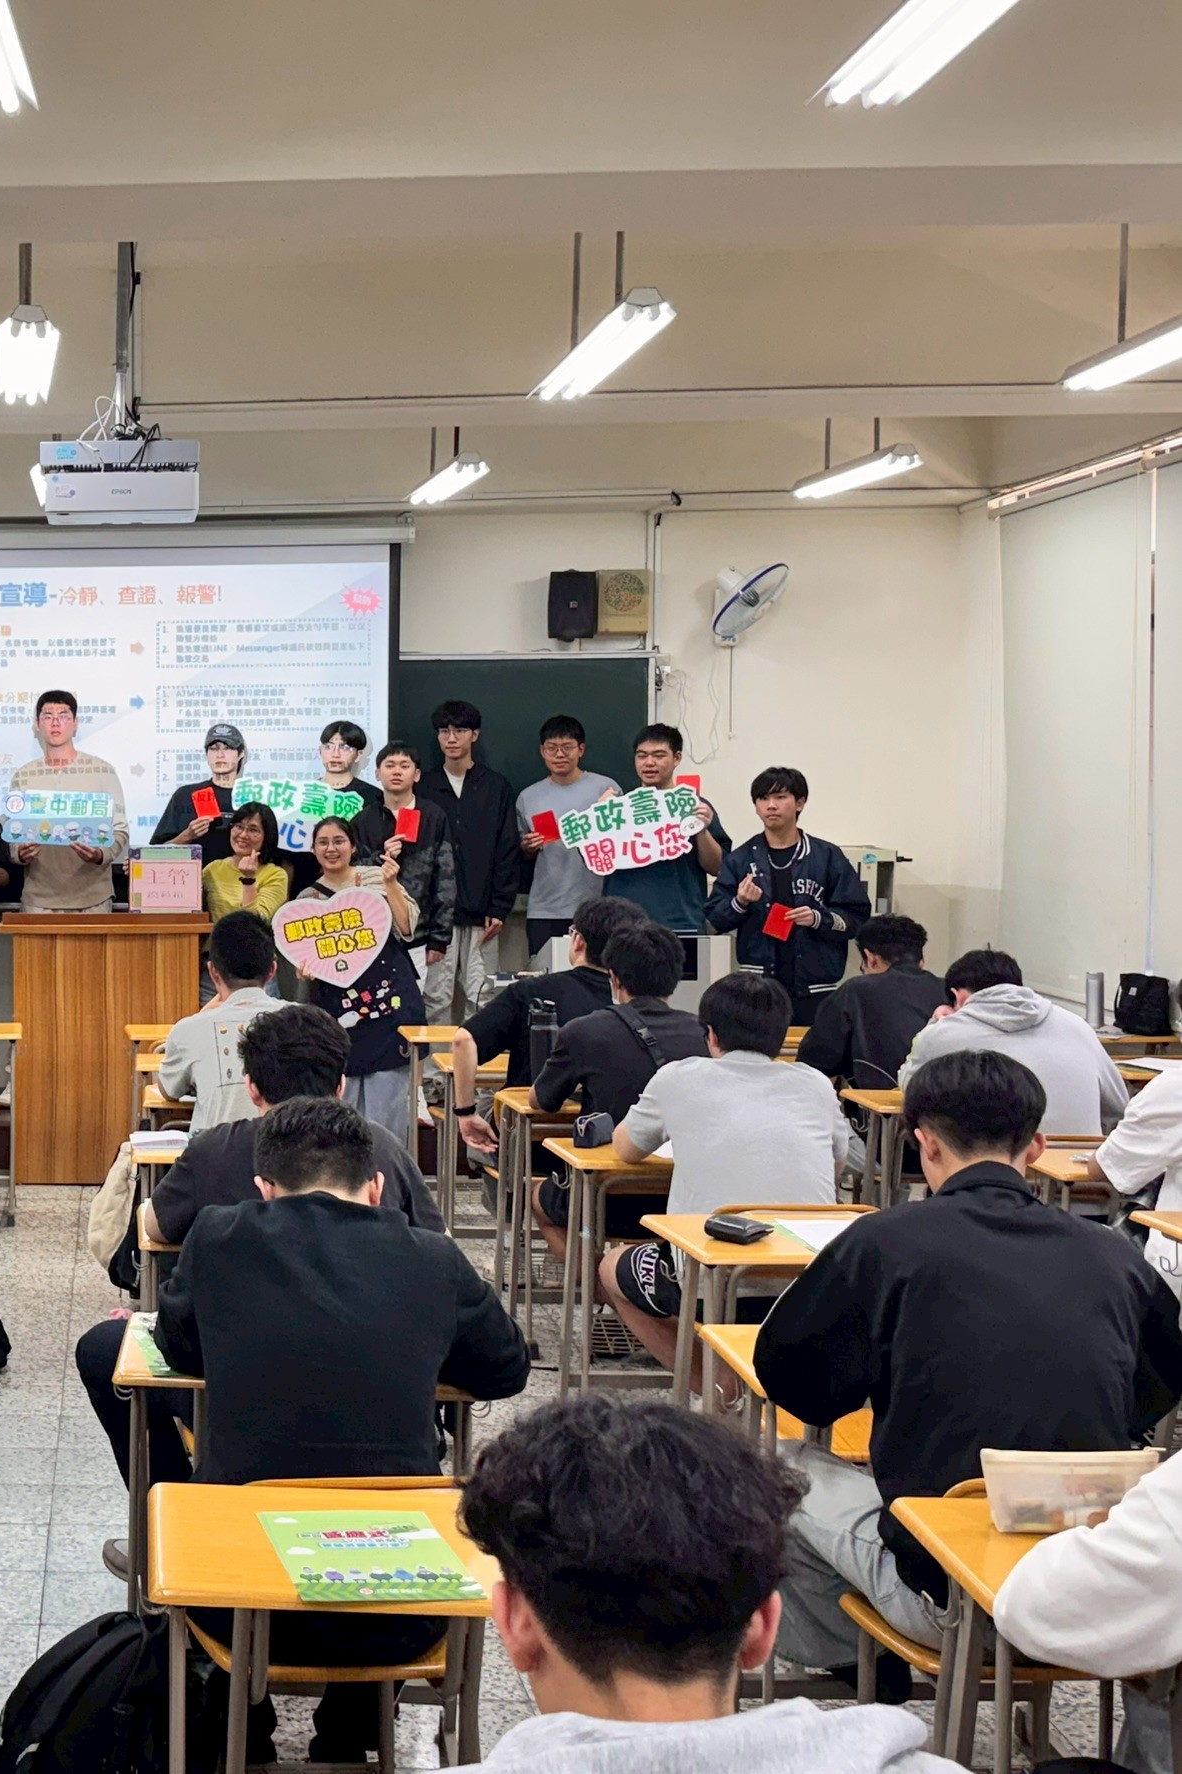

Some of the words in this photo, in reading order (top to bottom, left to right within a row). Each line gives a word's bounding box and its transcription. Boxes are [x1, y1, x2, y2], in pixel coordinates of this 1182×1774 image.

[561, 787, 697, 845] 郵政壽險
[584, 823, 689, 873] 關心您
[284, 908, 364, 943] 郵政壽險
[315, 928, 377, 959] 關心您
[640, 1245, 660, 1295] NIKE
